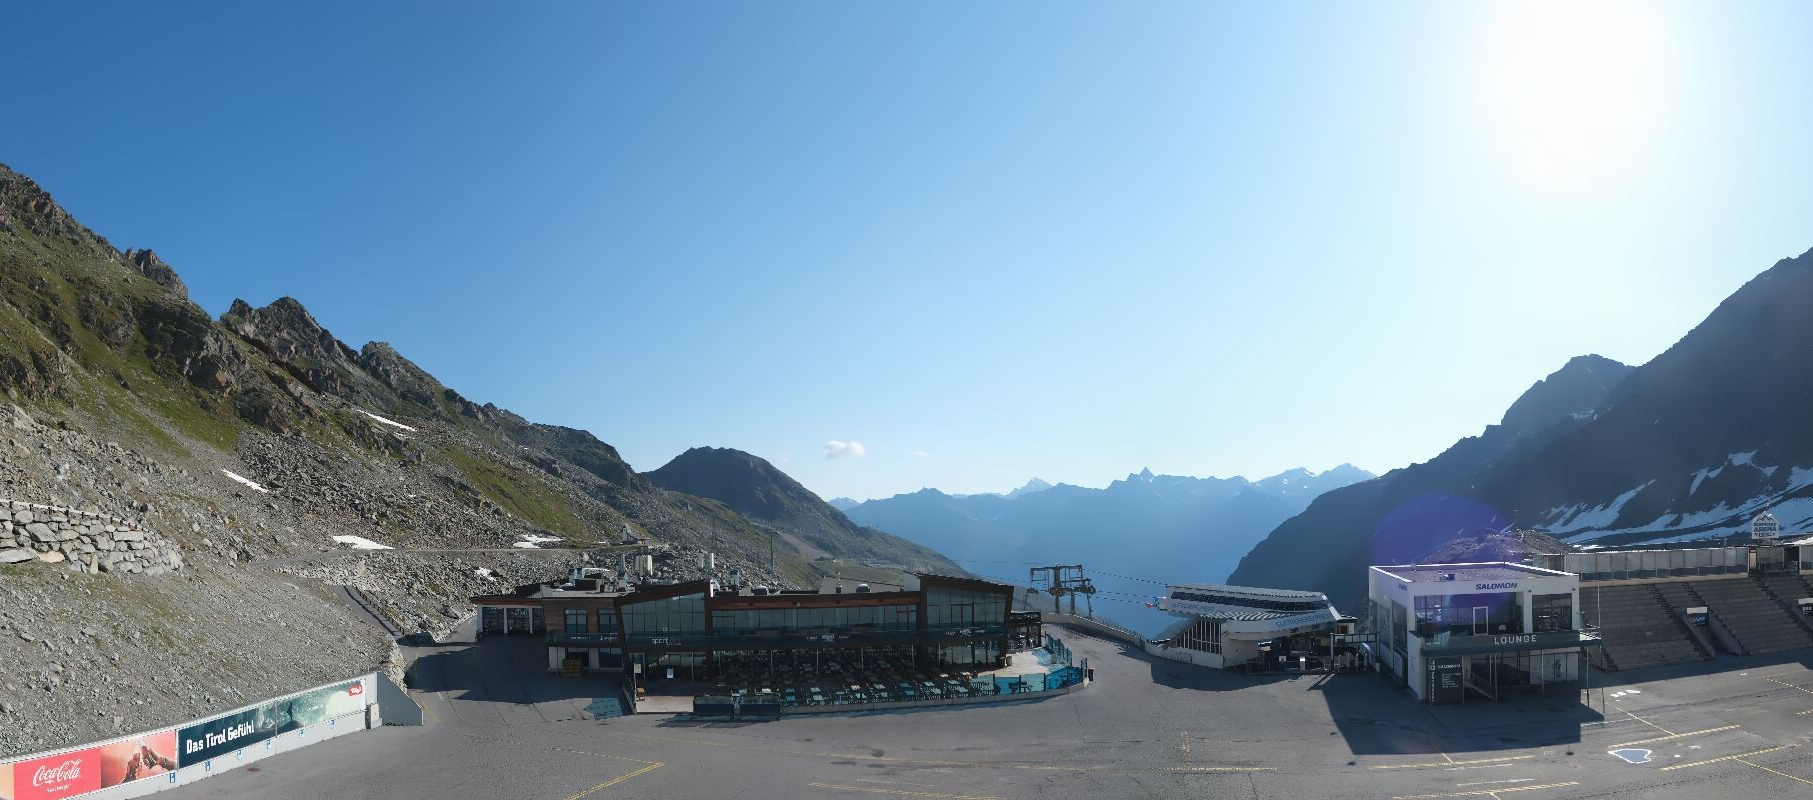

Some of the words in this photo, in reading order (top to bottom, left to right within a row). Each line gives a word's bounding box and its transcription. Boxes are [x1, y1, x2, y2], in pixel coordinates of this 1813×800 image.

[1476, 582, 1517, 590] SALOMON
[1494, 635, 1537, 645] LOUNGE
[186, 738, 204, 755] Das
[206, 728, 227, 748] Tirol
[228, 720, 255, 741] Gefühl
